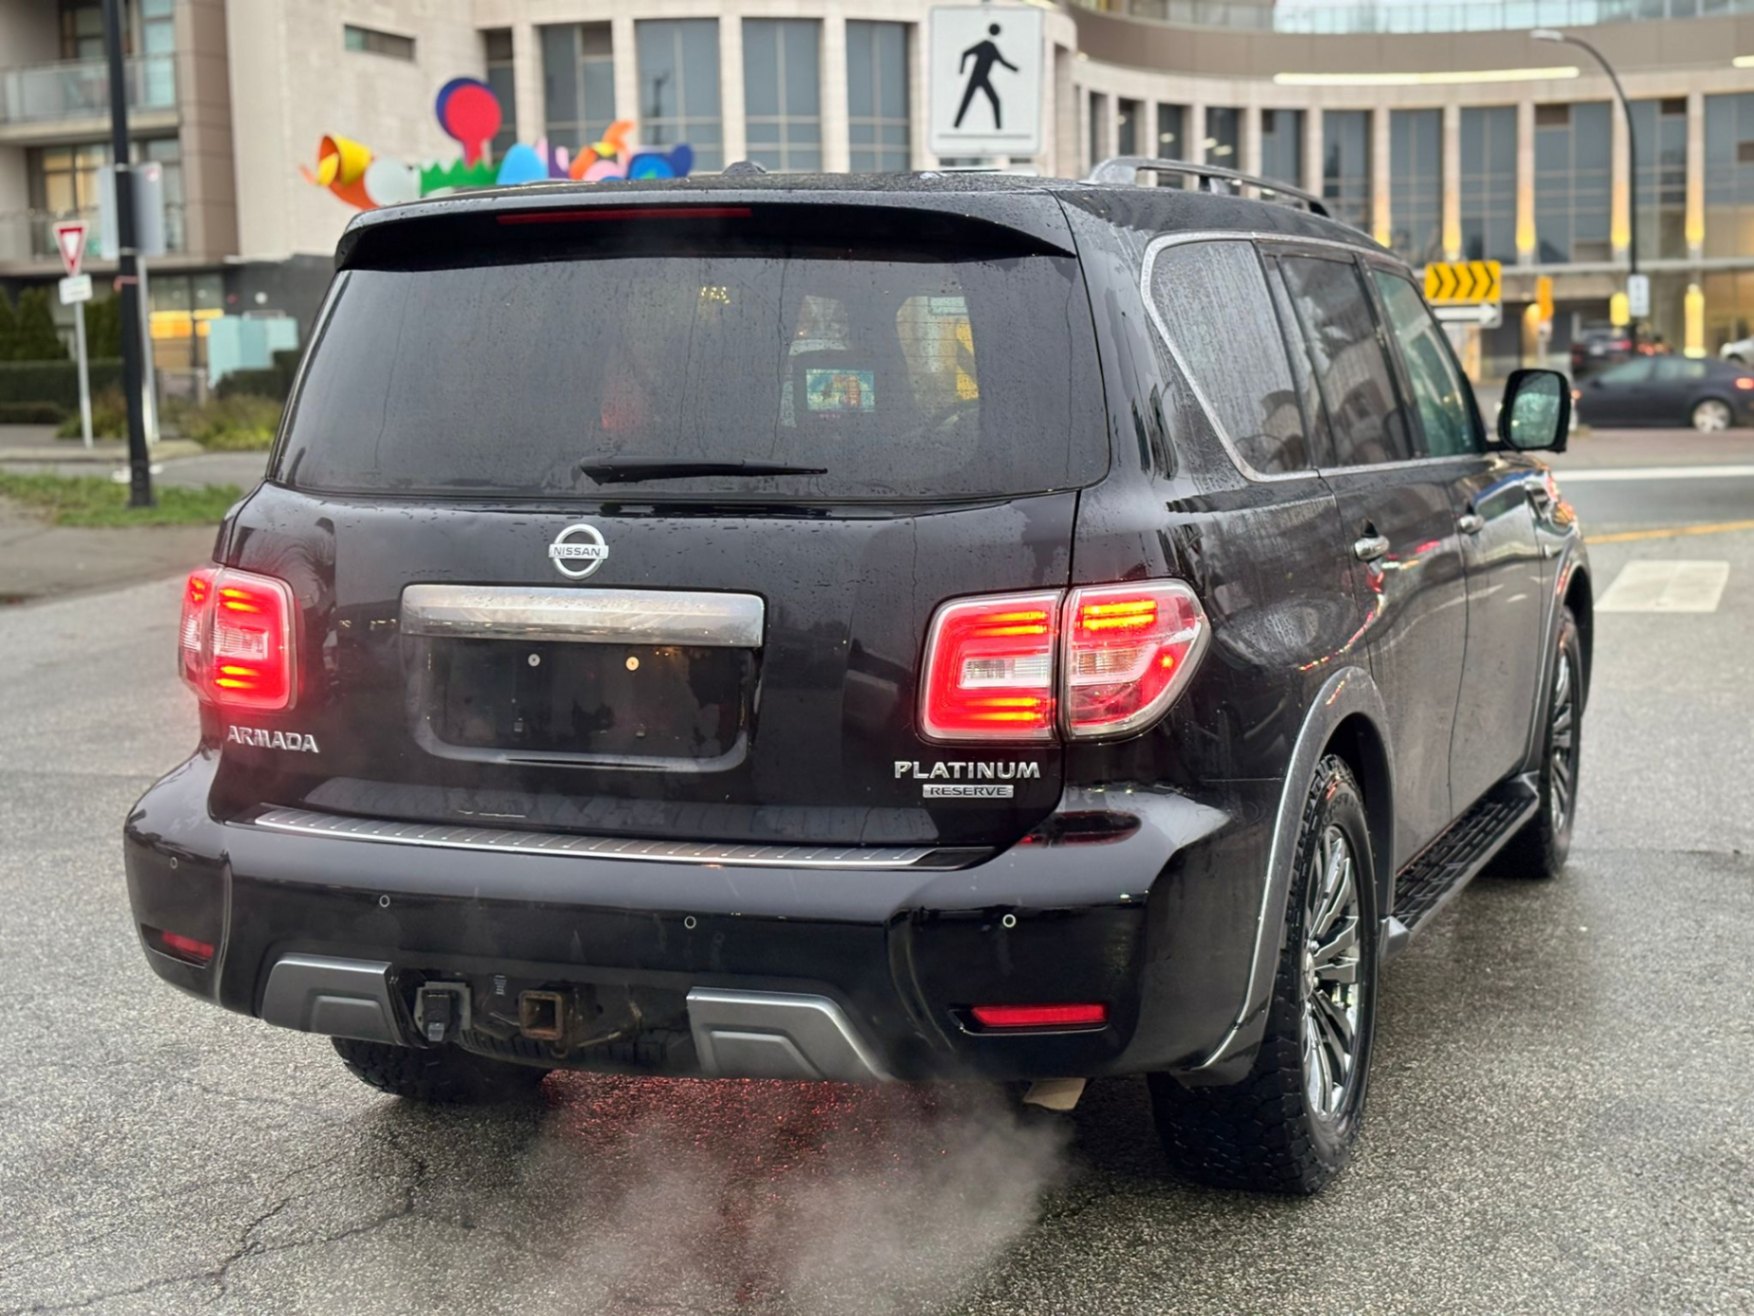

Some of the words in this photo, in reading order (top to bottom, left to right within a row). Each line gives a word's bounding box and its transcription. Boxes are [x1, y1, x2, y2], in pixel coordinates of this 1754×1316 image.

[553, 546, 601, 557] NISSAN
[227, 724, 319, 754] ARMADA
[894, 761, 1041, 779] PLATINUM
[929, 786, 1008, 797] RESERVE
